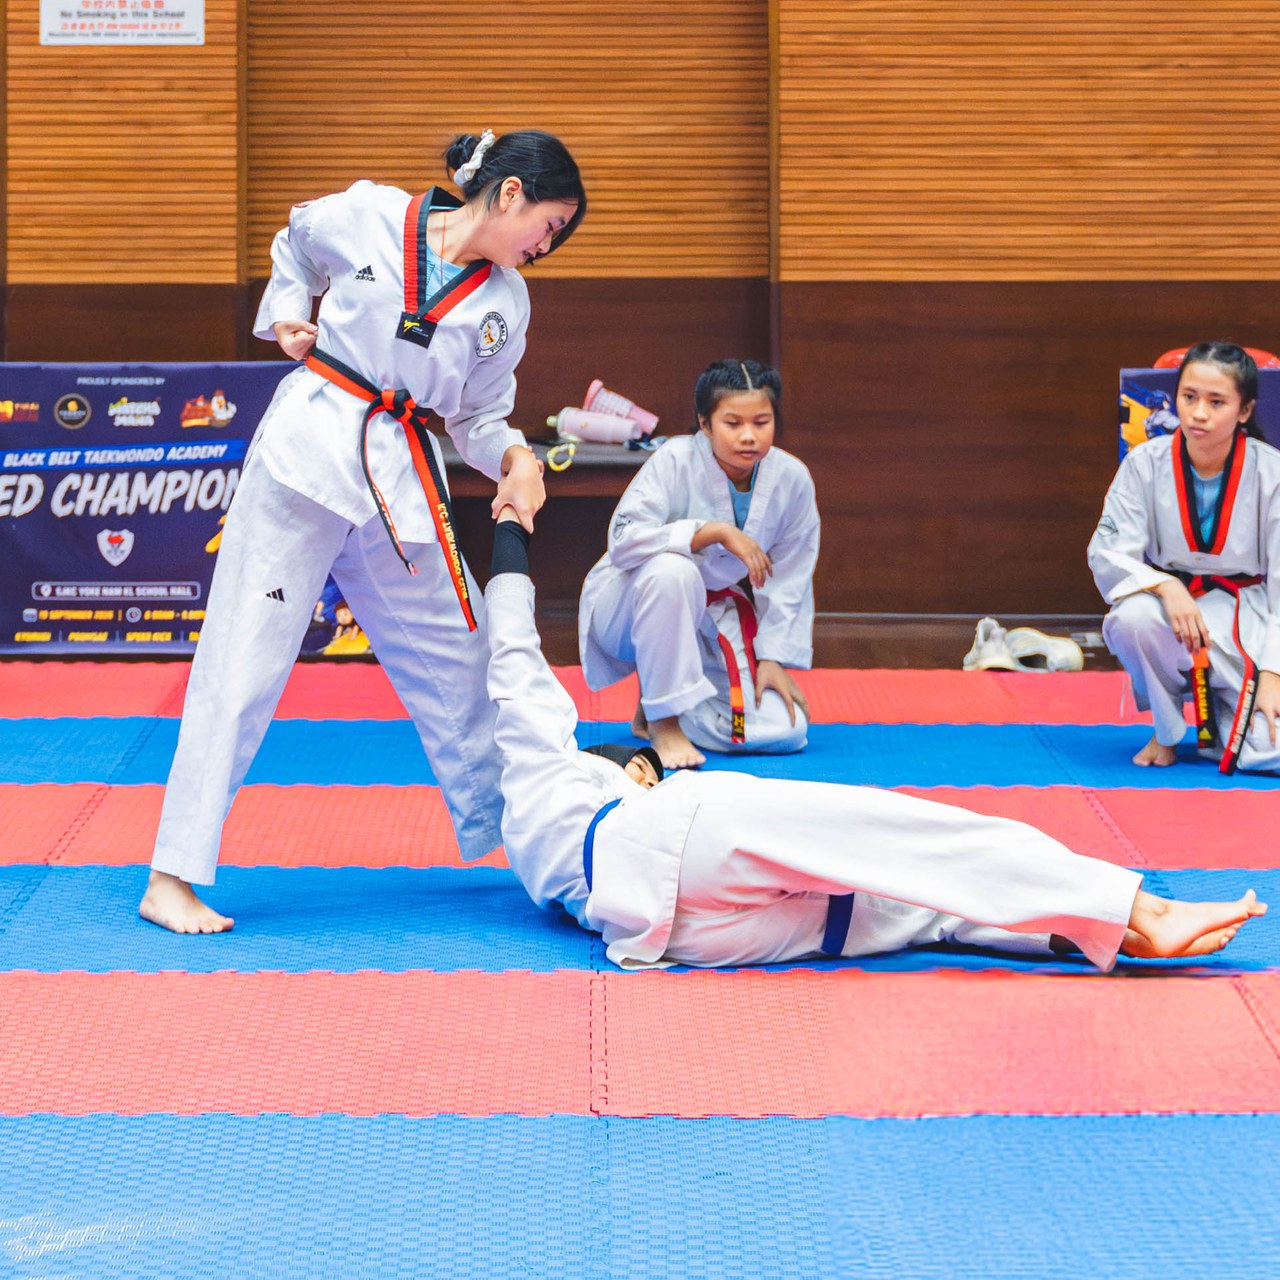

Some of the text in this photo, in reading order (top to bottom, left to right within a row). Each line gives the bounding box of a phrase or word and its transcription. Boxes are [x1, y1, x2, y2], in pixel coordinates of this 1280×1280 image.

[76, 10, 116, 20] Smoking
[132, 10, 149, 18] this
[152, 10, 186, 18] School
[3, 444, 228, 468] BLACK BELT TAEKWONDO ACADEMY
